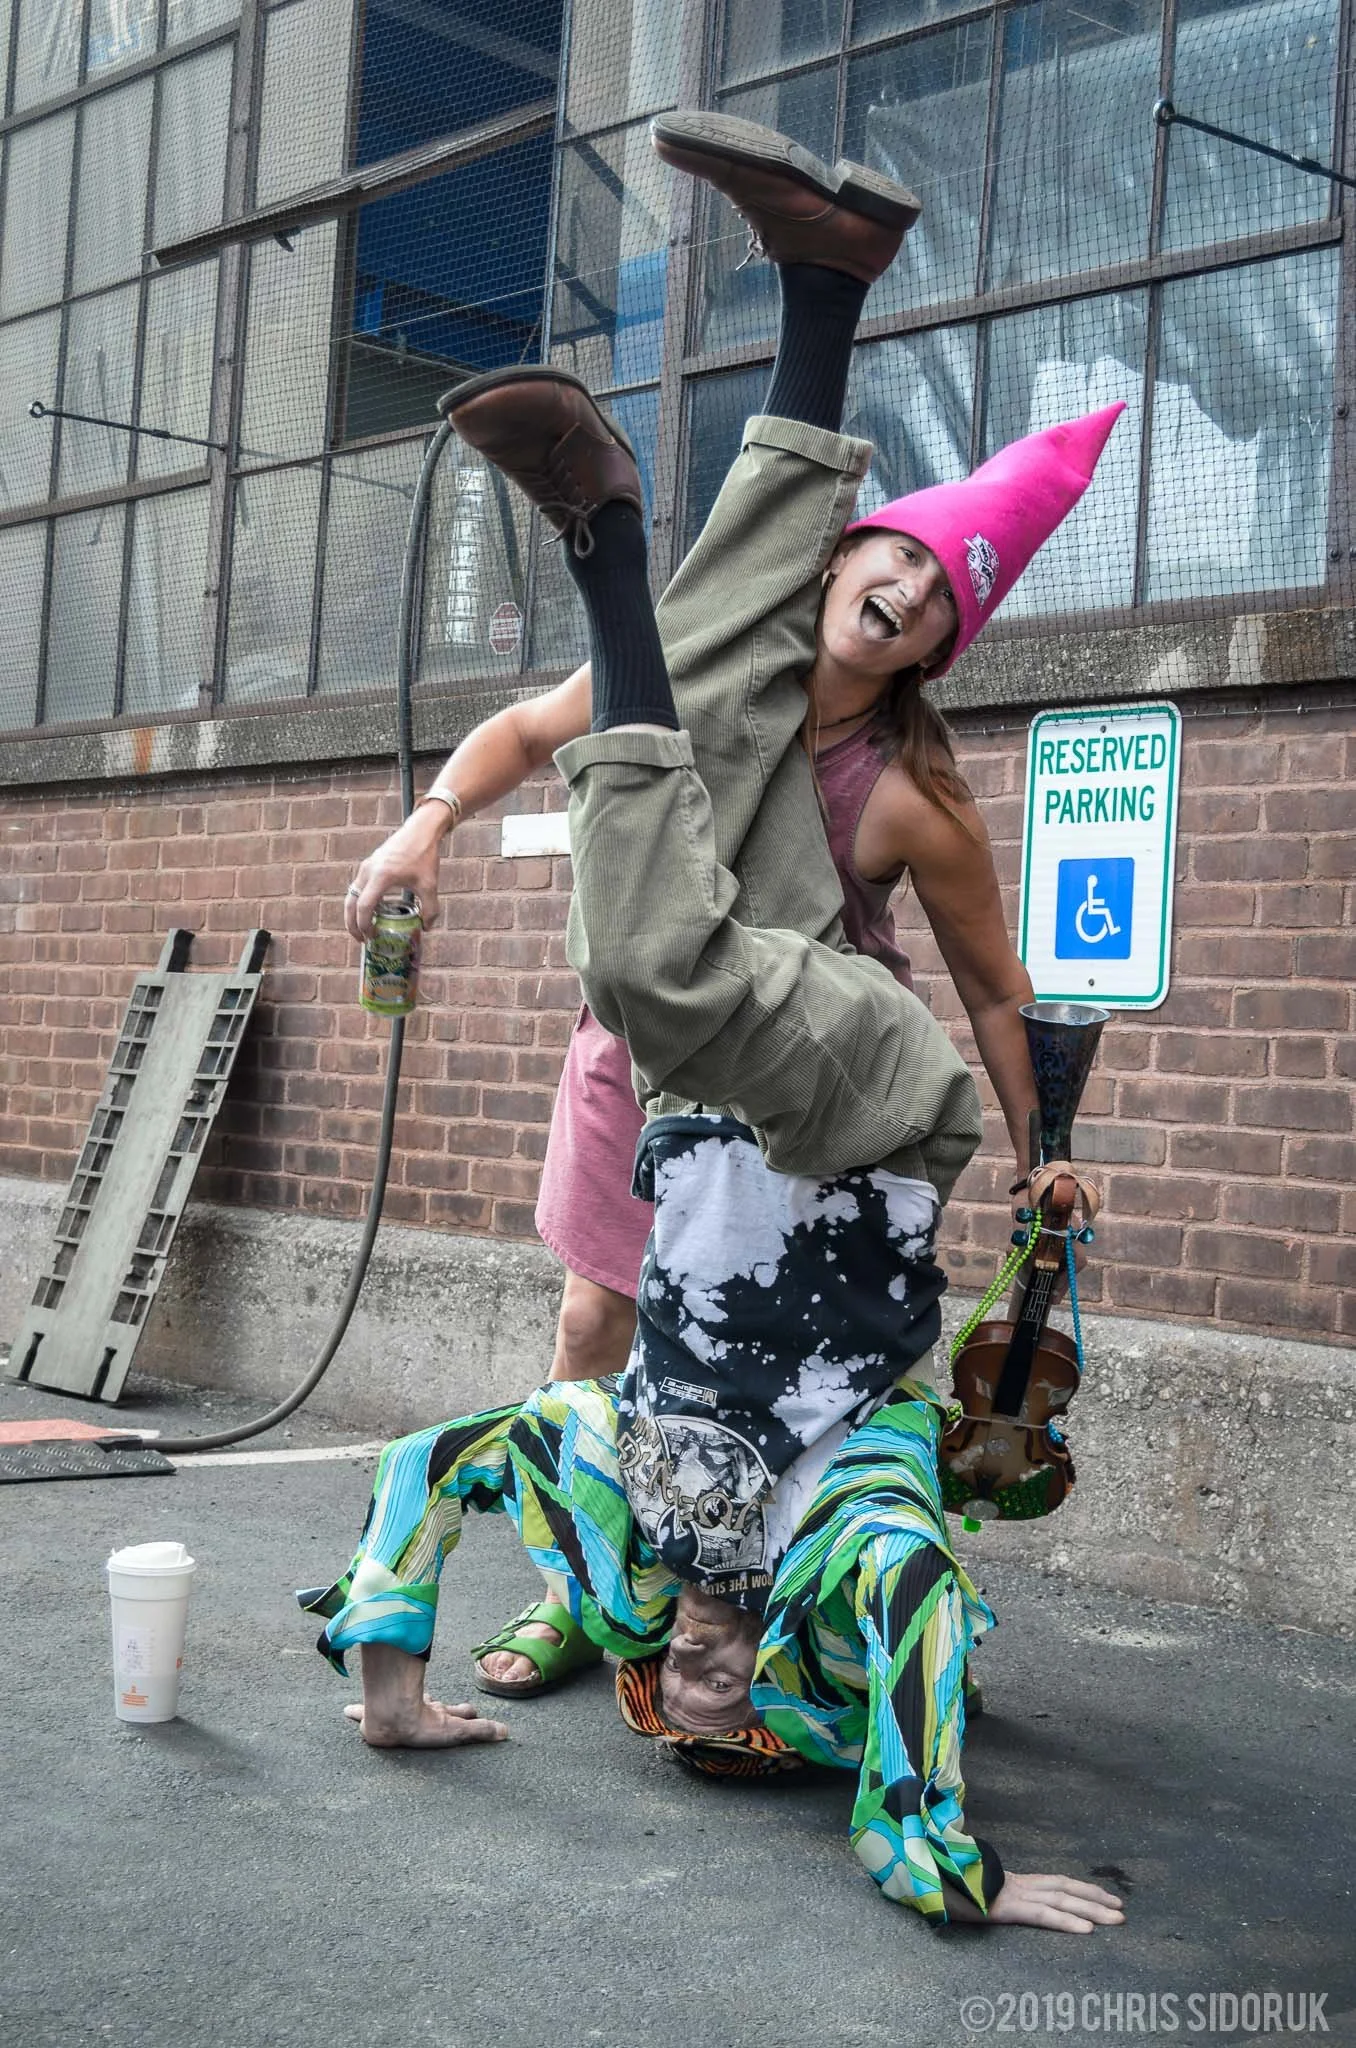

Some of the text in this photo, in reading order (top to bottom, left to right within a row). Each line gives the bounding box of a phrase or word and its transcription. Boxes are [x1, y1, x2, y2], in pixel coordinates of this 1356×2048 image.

[1039, 734, 1166, 775] RESERVED
[1045, 785, 1155, 824] PARKING
[729, 1577, 749, 1592] THE
